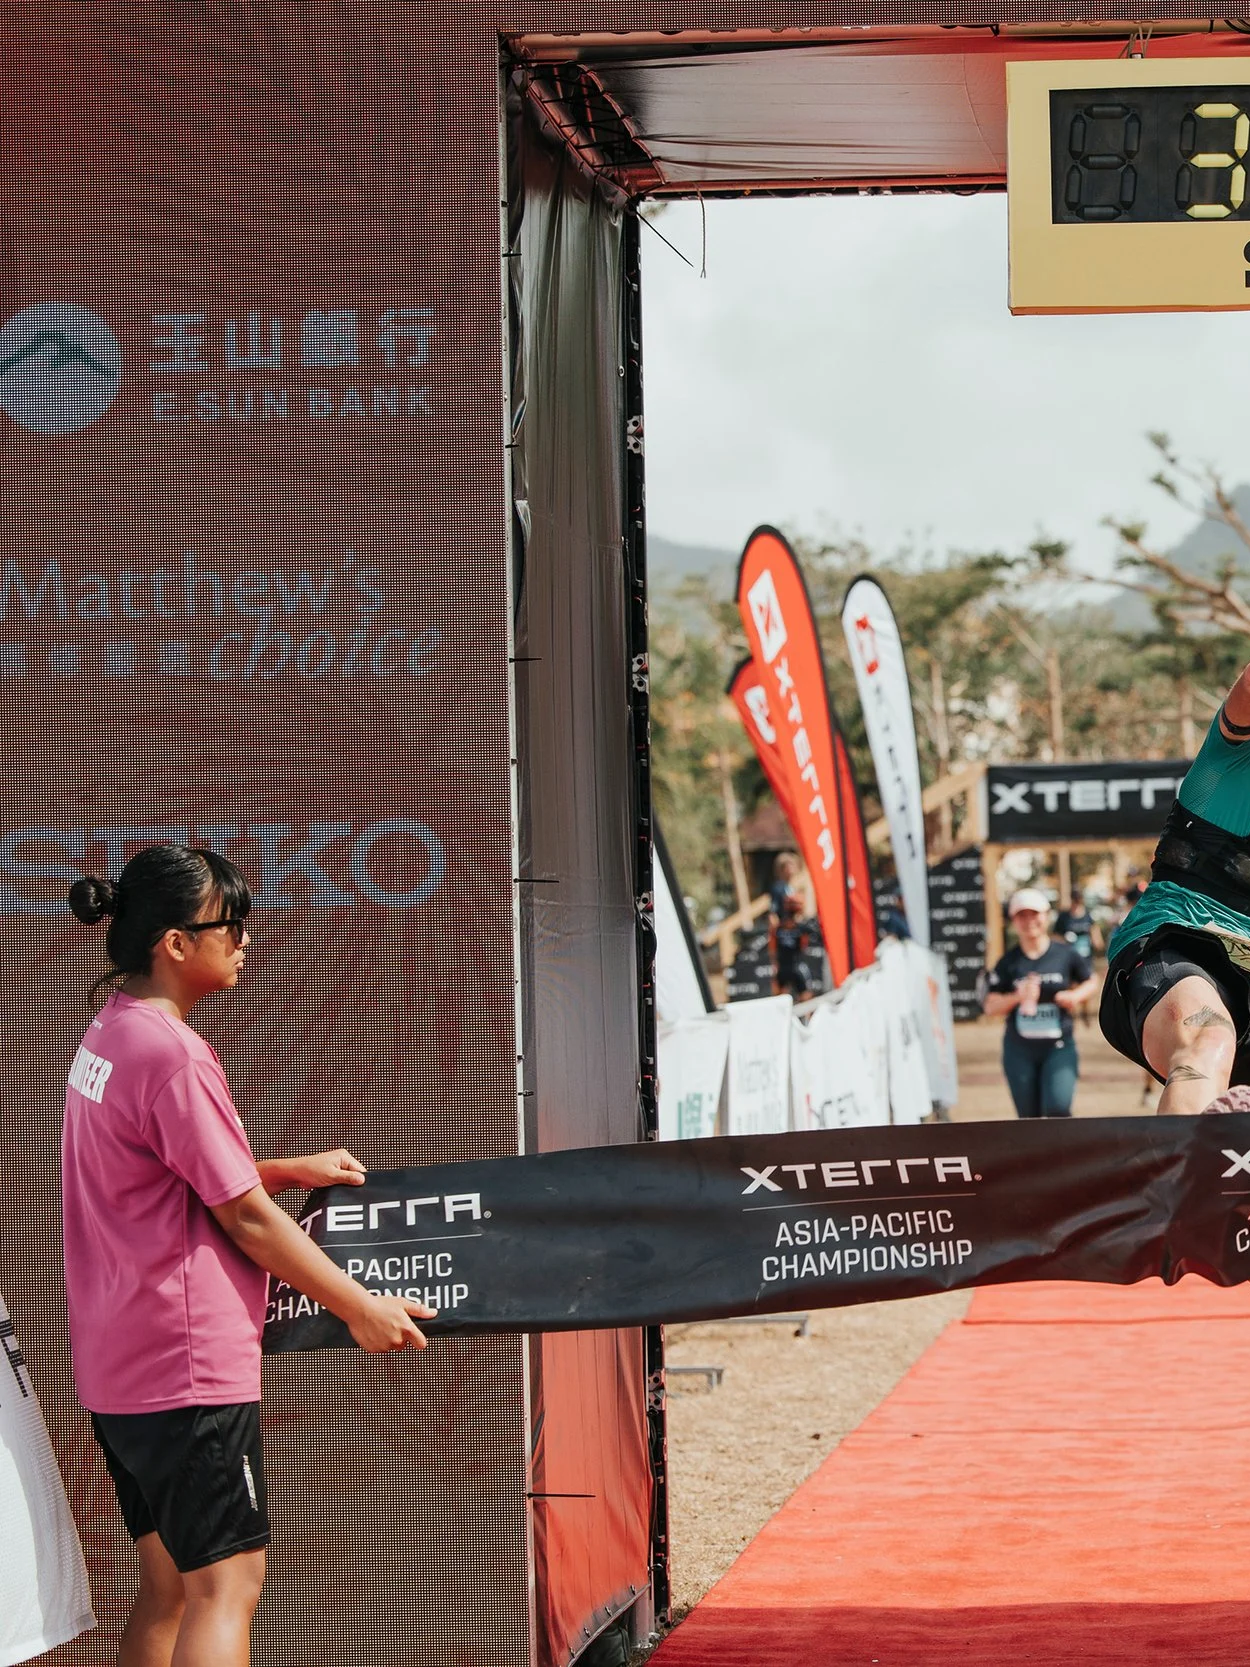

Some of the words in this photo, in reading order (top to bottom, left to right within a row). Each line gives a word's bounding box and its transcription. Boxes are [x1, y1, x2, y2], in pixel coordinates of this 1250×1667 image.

[308, 384, 435, 419] BANK
[208, 602, 443, 681] choice
[990, 776, 1187, 815] XTERR
[775, 1208, 954, 1247] ASIA-PACIFIC
[761, 1238, 974, 1283] CHAMPIONSHIP
